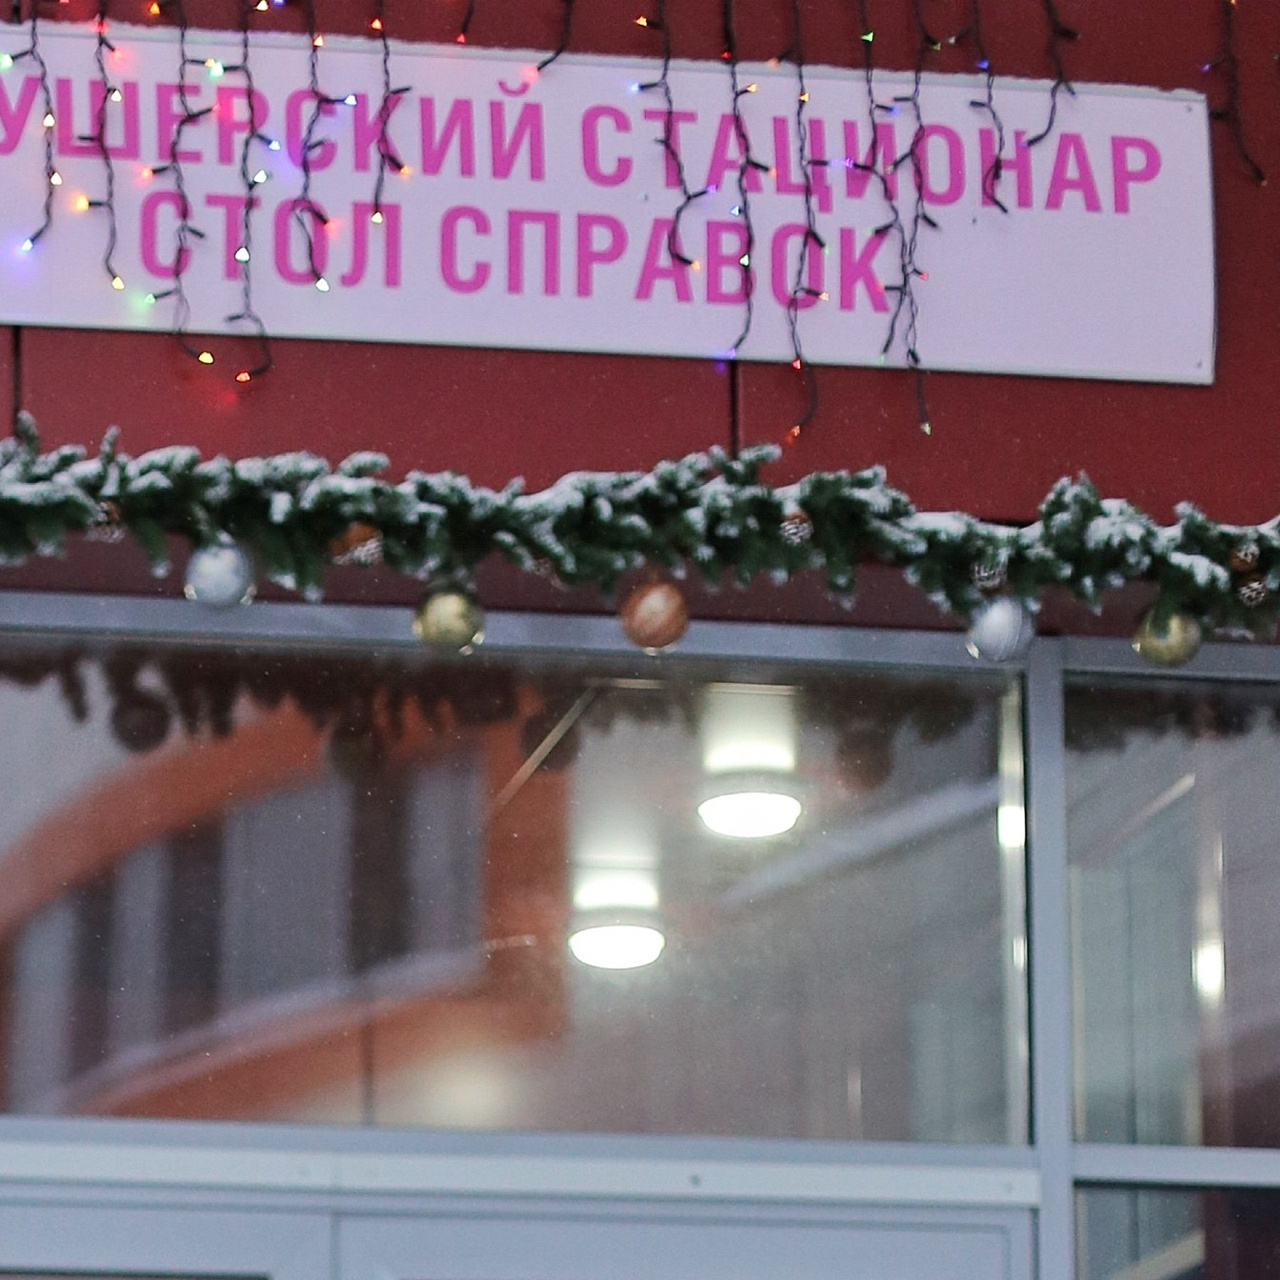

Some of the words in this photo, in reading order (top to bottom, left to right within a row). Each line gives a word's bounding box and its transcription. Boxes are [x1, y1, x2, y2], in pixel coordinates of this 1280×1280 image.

[581, 105, 1161, 214] СТАЦИОНАР
[139, 189, 402, 289] СТОЛ
[438, 205, 890, 313] СПРАВОК
